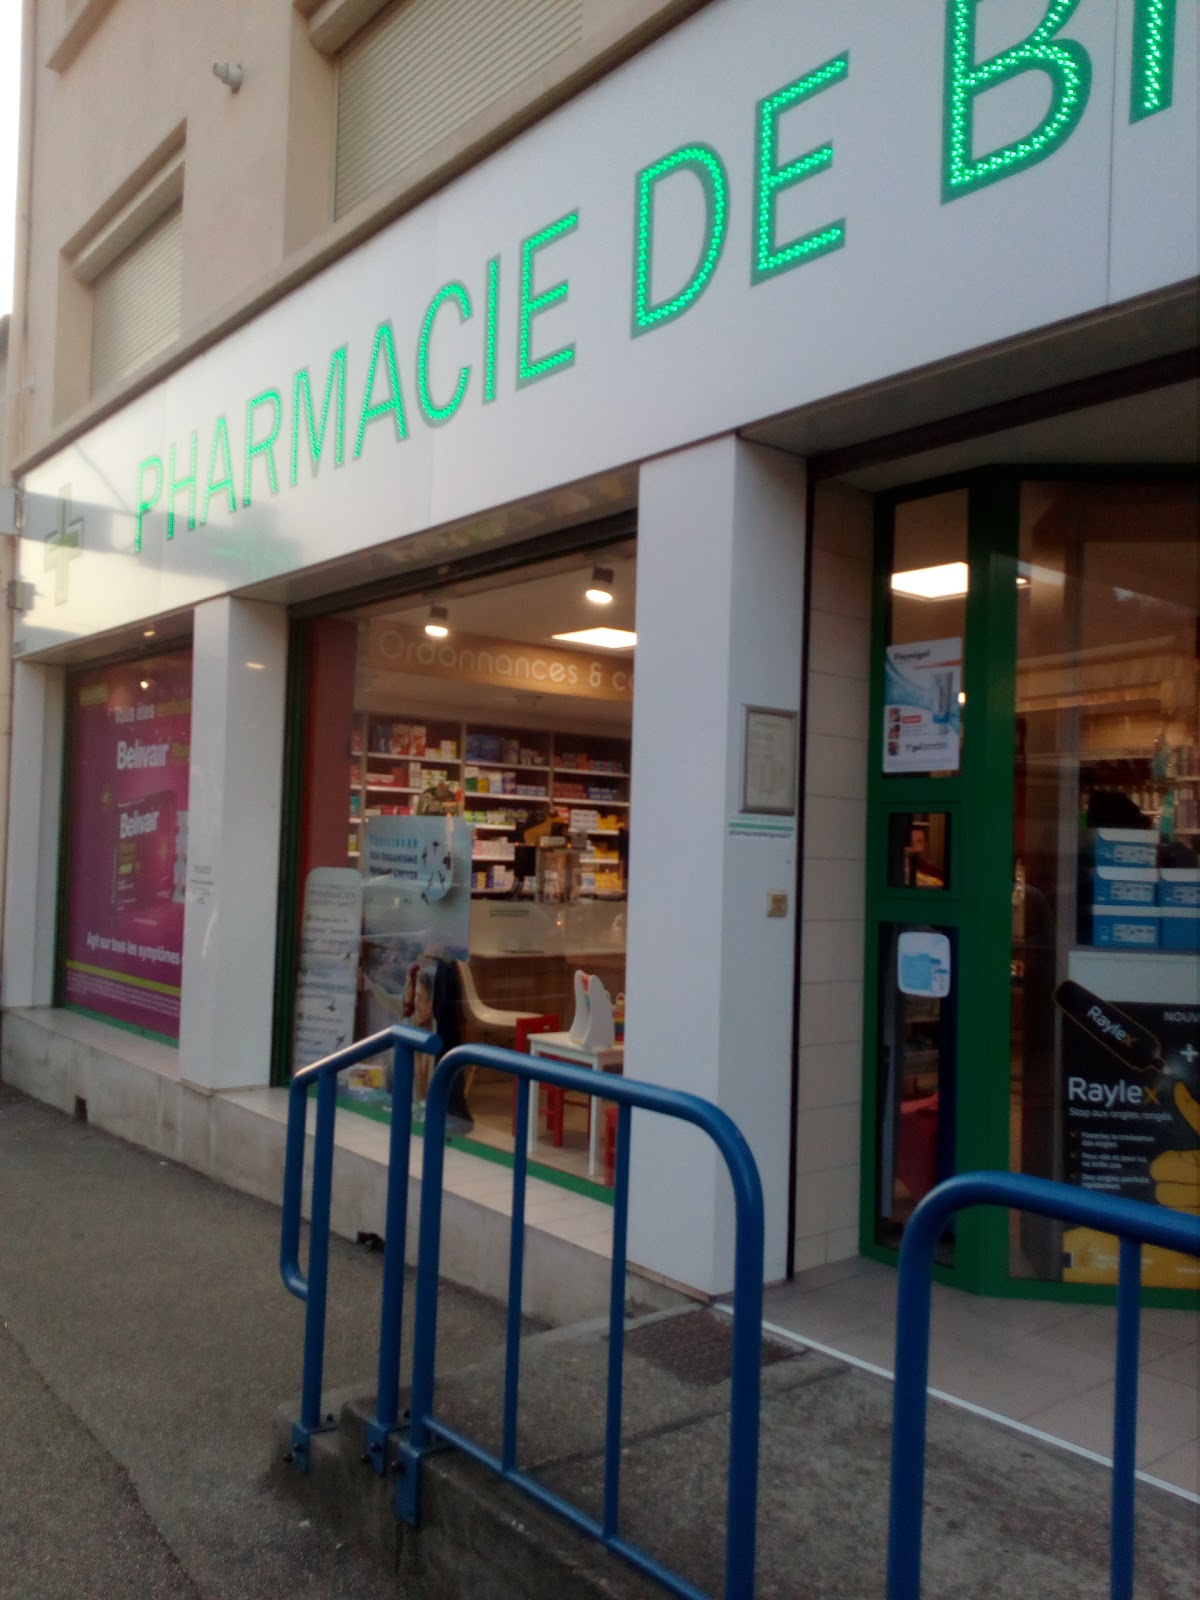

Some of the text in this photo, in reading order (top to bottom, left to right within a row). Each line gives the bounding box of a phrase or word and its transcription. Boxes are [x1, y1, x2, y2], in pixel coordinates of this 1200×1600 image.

[134, 207, 579, 554] PHARMACIE
[630, 49, 850, 340] DE
[379, 630, 577, 685] Ordonnances
[589, 662, 602, 689] &
[1086, 1005, 1137, 1047] Raylex
[1068, 1076, 1159, 1108] Raylex
